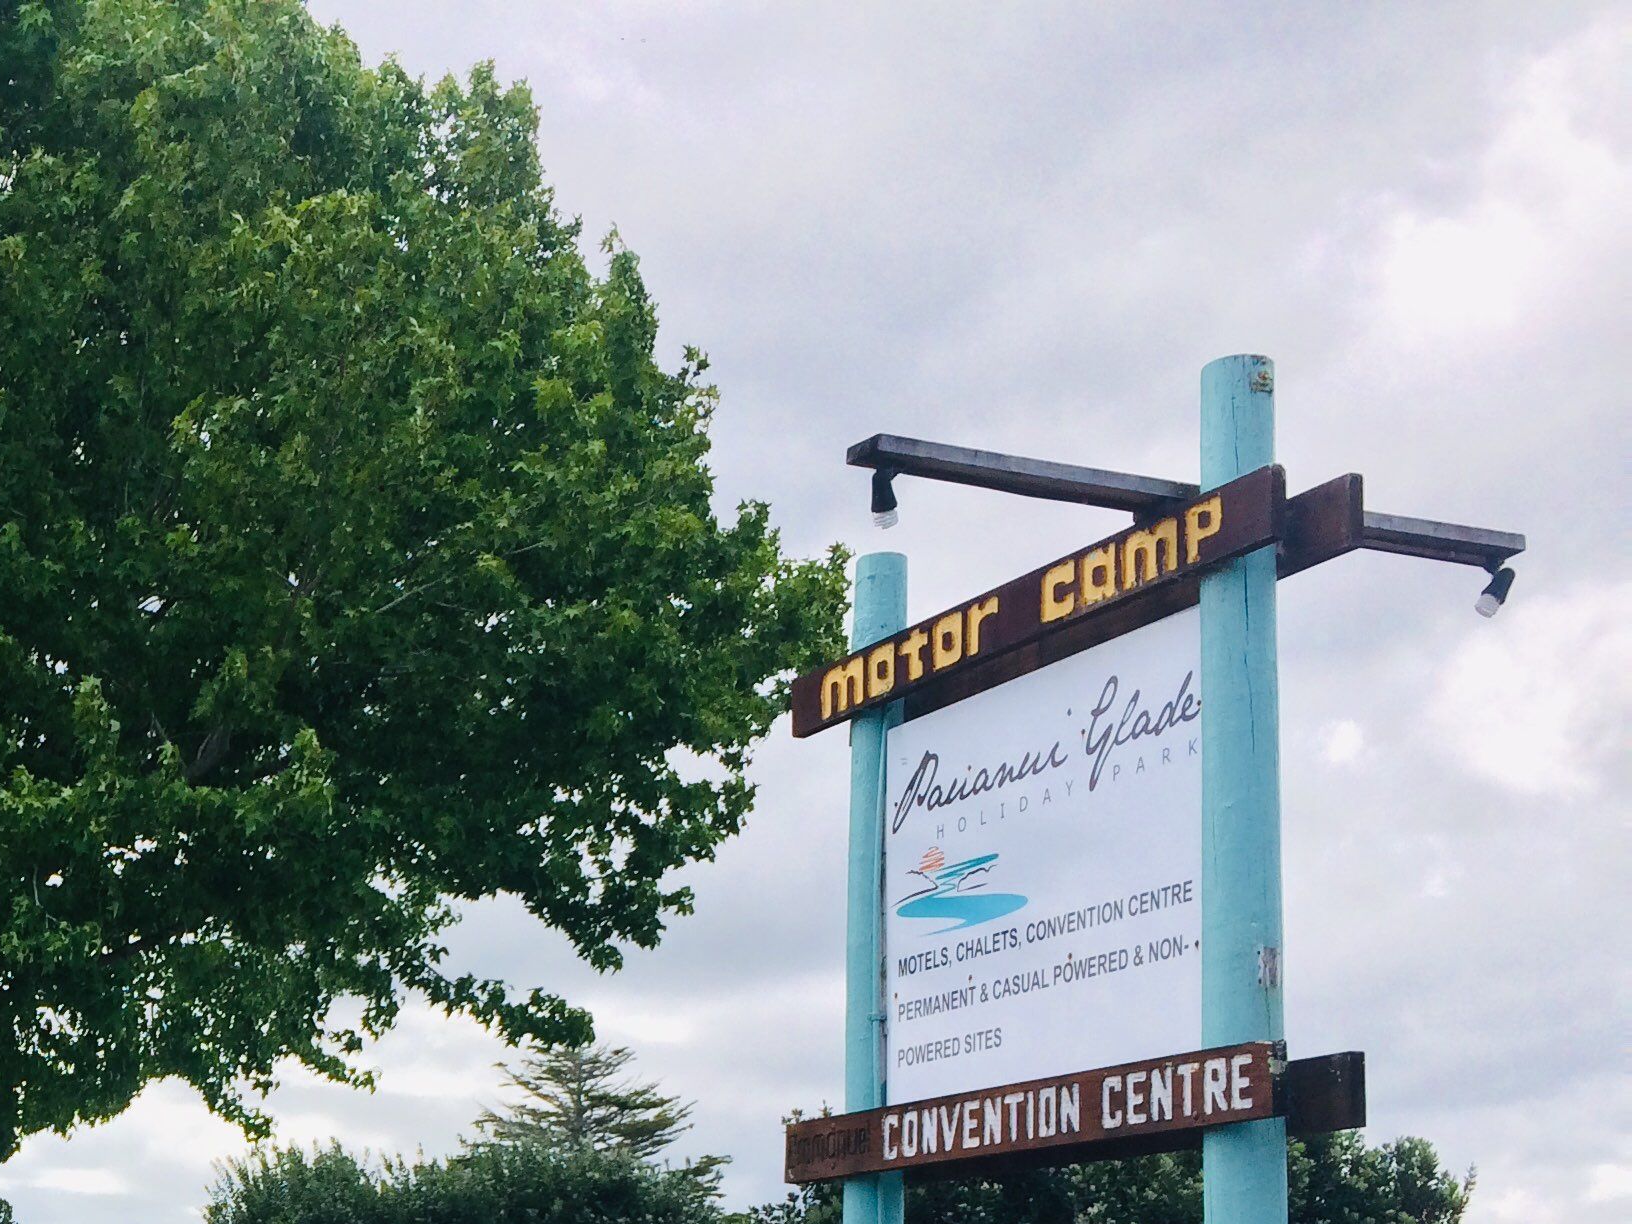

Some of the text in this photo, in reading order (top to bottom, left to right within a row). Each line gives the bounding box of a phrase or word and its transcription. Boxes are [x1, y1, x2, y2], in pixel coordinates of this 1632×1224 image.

[936, 737, 1198, 840] HOLIDAY PARK
[898, 879, 1193, 978] MOTELS, CHALETS, CONVENTION CENTRE
[898, 934, 1190, 1023] PERMANENT & CASUAL POWERED & NON-
[897, 1027, 1002, 1068] POWERED SITES
[882, 1082, 1081, 1161] CONVENTION
[1102, 1053, 1255, 1130] CENTRE
